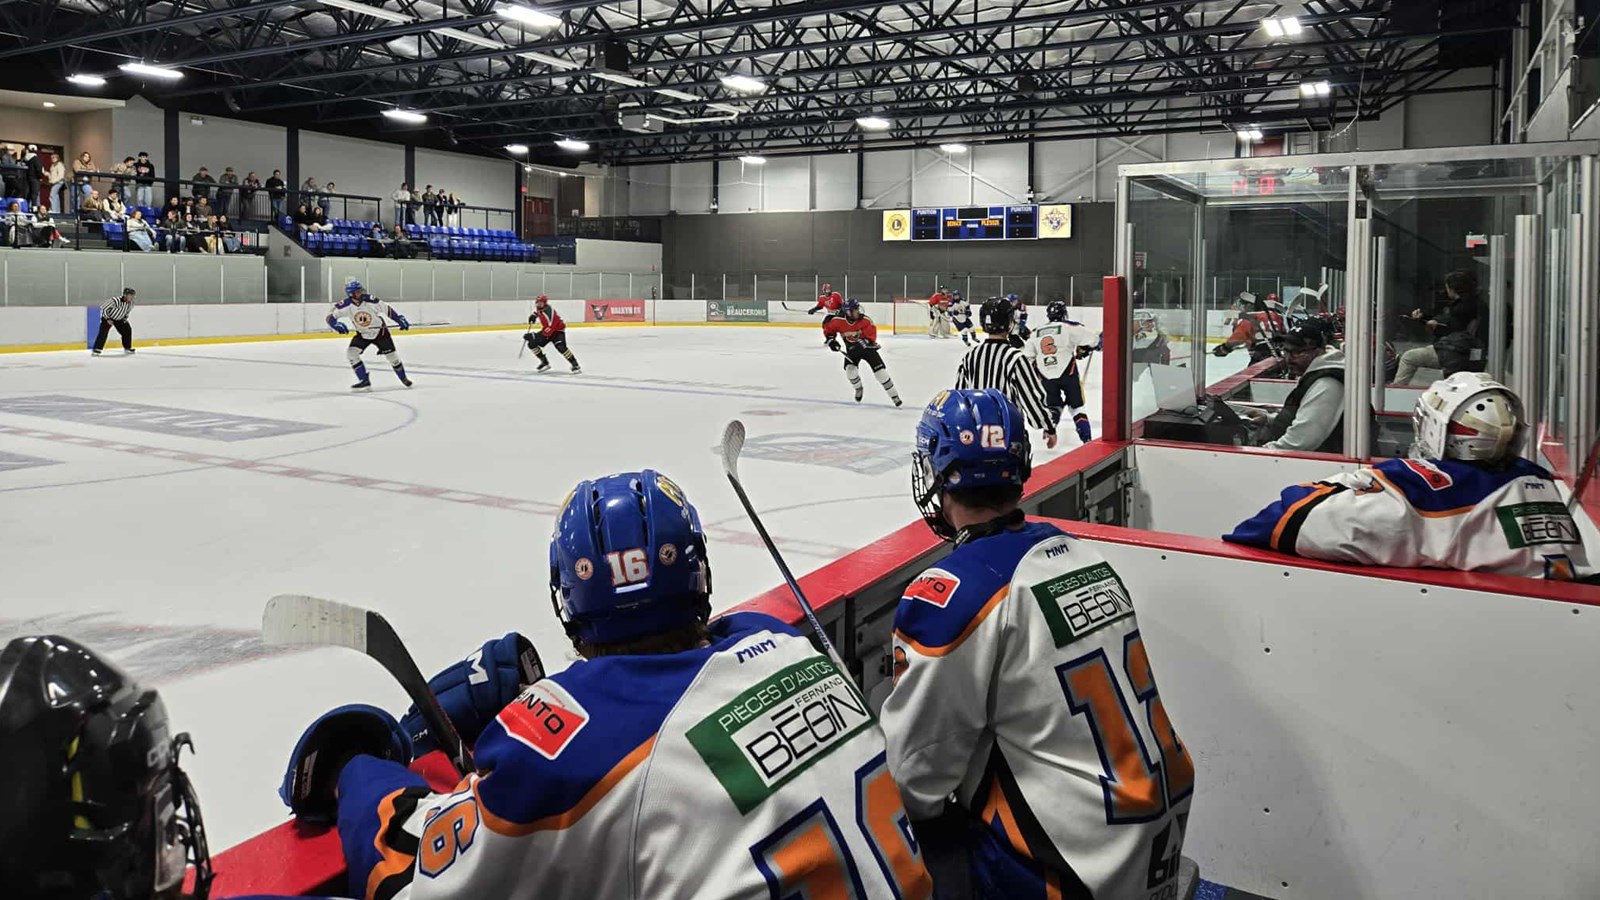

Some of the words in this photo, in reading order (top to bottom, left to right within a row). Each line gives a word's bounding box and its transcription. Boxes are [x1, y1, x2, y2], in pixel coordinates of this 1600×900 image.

[980, 425, 1006, 449] 12
[1045, 543, 1069, 559] MNM
[606, 548, 650, 587] 16
[735, 639, 777, 664] MNM
[718, 684, 782, 732] PIÈCES
[780, 661, 834, 694] D'AUTOS
[794, 677, 843, 706] FERNAND
